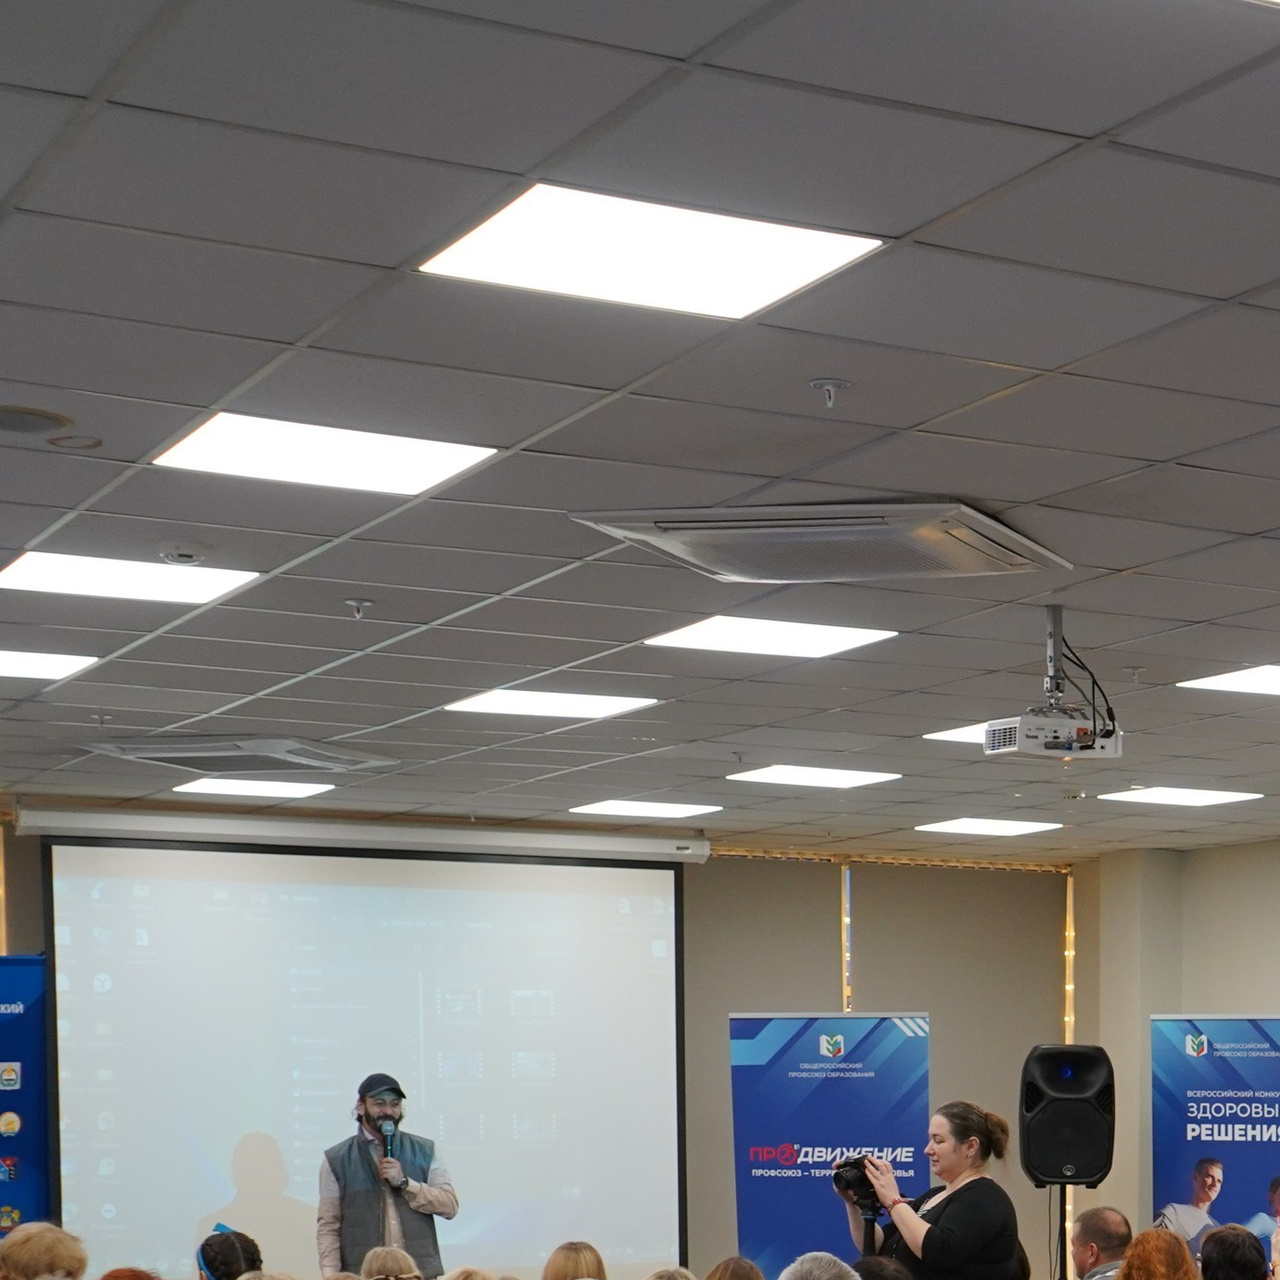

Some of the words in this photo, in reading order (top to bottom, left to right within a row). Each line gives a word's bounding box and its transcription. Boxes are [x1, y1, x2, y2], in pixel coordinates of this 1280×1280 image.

[0, 1001, 24, 1014] КИЙ
[1186, 1090, 1253, 1098] ВСЕРОССИЙСКИЙ
[752, 1169, 802, 1177] ПРОФСОЮЗ
